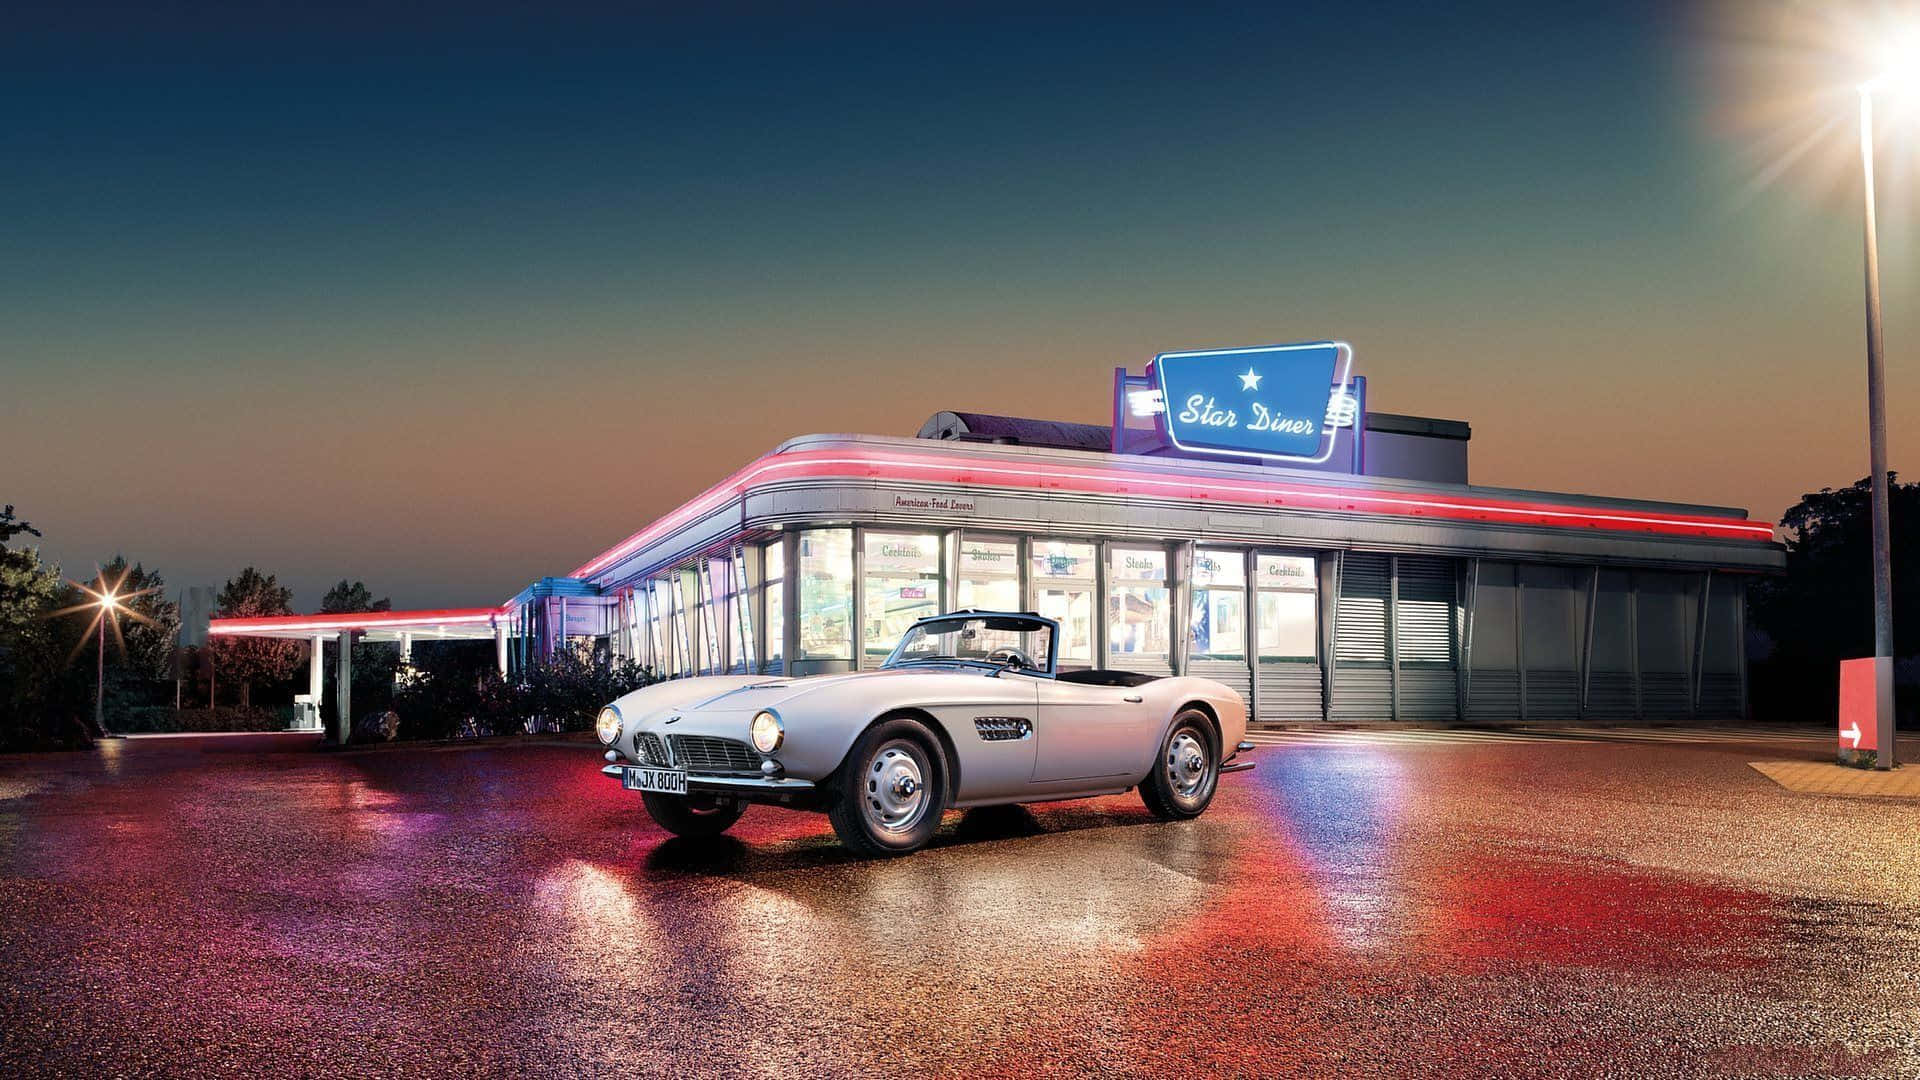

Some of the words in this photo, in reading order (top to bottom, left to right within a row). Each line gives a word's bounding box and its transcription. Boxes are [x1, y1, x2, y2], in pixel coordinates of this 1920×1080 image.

[1179, 394, 1238, 427] Star
[1247, 402, 1315, 435] Diner
[950, 499, 976, 510] Lovers
[882, 545, 922, 559] Cocktails
[971, 549, 1001, 561] Shakes
[1125, 556, 1153, 569] Steaks
[1269, 565, 1305, 577] Cocktails
